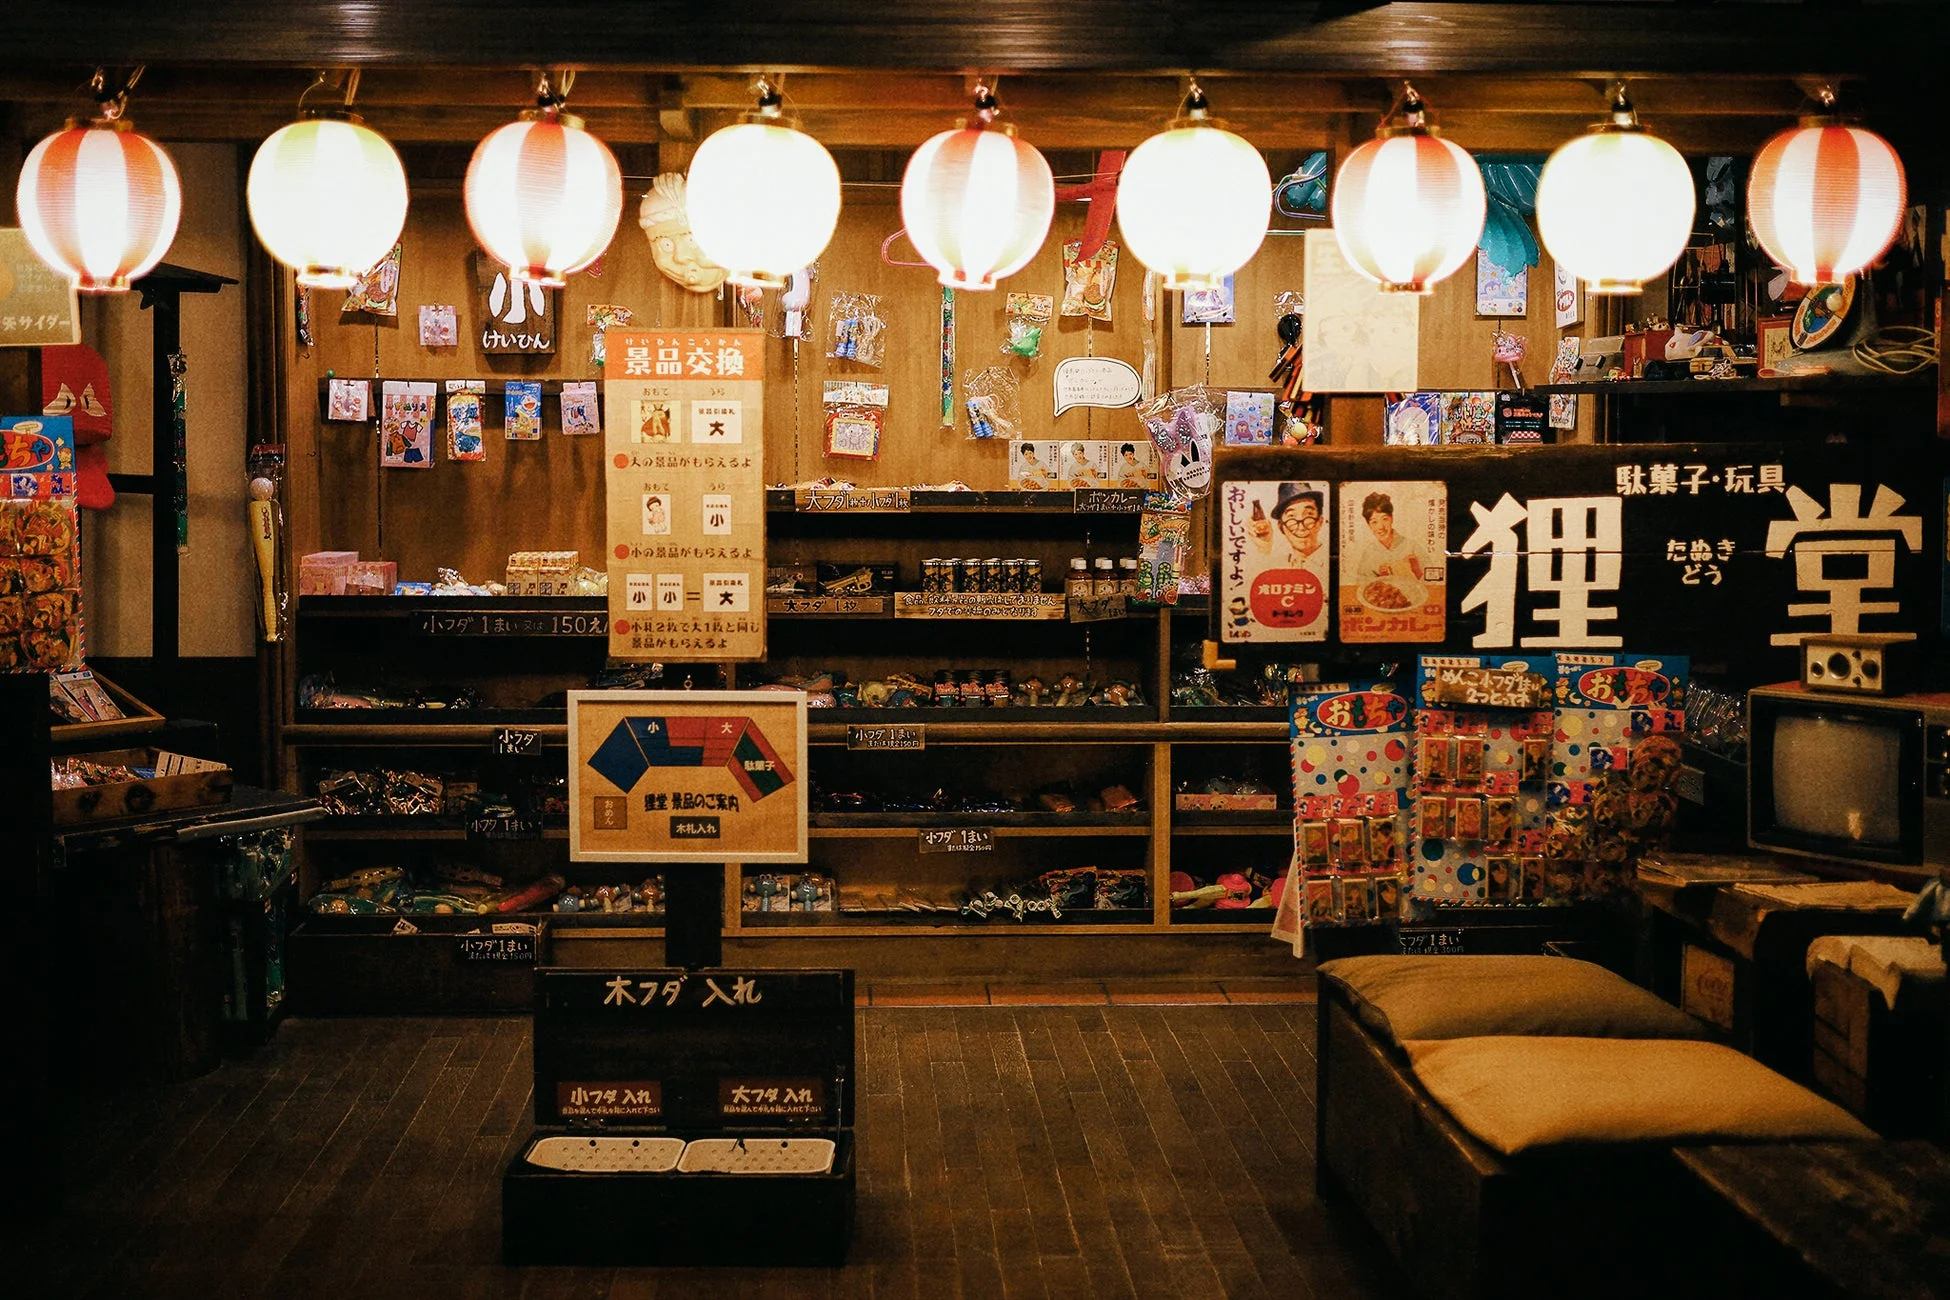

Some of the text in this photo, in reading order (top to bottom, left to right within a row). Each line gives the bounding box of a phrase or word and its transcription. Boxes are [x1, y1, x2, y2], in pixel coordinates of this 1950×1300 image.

[488, 272, 545, 324] 小
[482, 330, 550, 350] けいひん
[624, 346, 745, 377] 景品交換
[643, 387, 670, 397] おもて
[709, 420, 725, 437] 大
[630, 457, 752, 469] 大の景品がもらえるよ
[1616, 464, 1786, 495] 駄菓子・玩具
[1088, 490, 1138, 504] ボンカレー
[709, 513, 724, 527] 小
[630, 546, 753, 559] 小の景品がもらえるよ
[1666, 539, 1736, 563] たぬき
[1460, 491, 1623, 649] 狸
[1765, 483, 1923, 647] 堂
[1681, 565, 1723, 586] どう
[1257, 583, 1317, 595] オロナミン
[632, 591, 647, 604] 小
[663, 591, 677, 604] 小
[719, 590, 734, 606] 大
[1280, 595, 1296, 607] C
[783, 600, 827, 612] 大フダ
[423, 615, 474, 634] 小フダ
[481, 615, 518, 634] 1まい
[1342, 617, 1443, 633] ボンカレー
[631, 637, 728, 649] 景品がもらえるよ
[1586, 671, 1668, 703] おもちゃ
[1325, 694, 1405, 728] おもちゃ
[647, 721, 733, 734] 小 大
[855, 729, 917, 741] 小フダ 1まい
[498, 729, 538, 745] 小フダ
[744, 760, 775, 772] 駄菓子
[671, 792, 740, 813] 景品のご案内
[604, 800, 614, 826] おめん
[675, 822, 717, 834] 木札入れ
[925, 829, 989, 844] 小フダ 1まい
[460, 939, 528, 953] 小フダ 1まい
[1430, 933, 1460, 946] 1まい
[603, 974, 762, 1007] 木フダ 入れ
[570, 1087, 652, 1106] 小フダ 入れ
[731, 1085, 814, 1104] 大フダ 入れ
